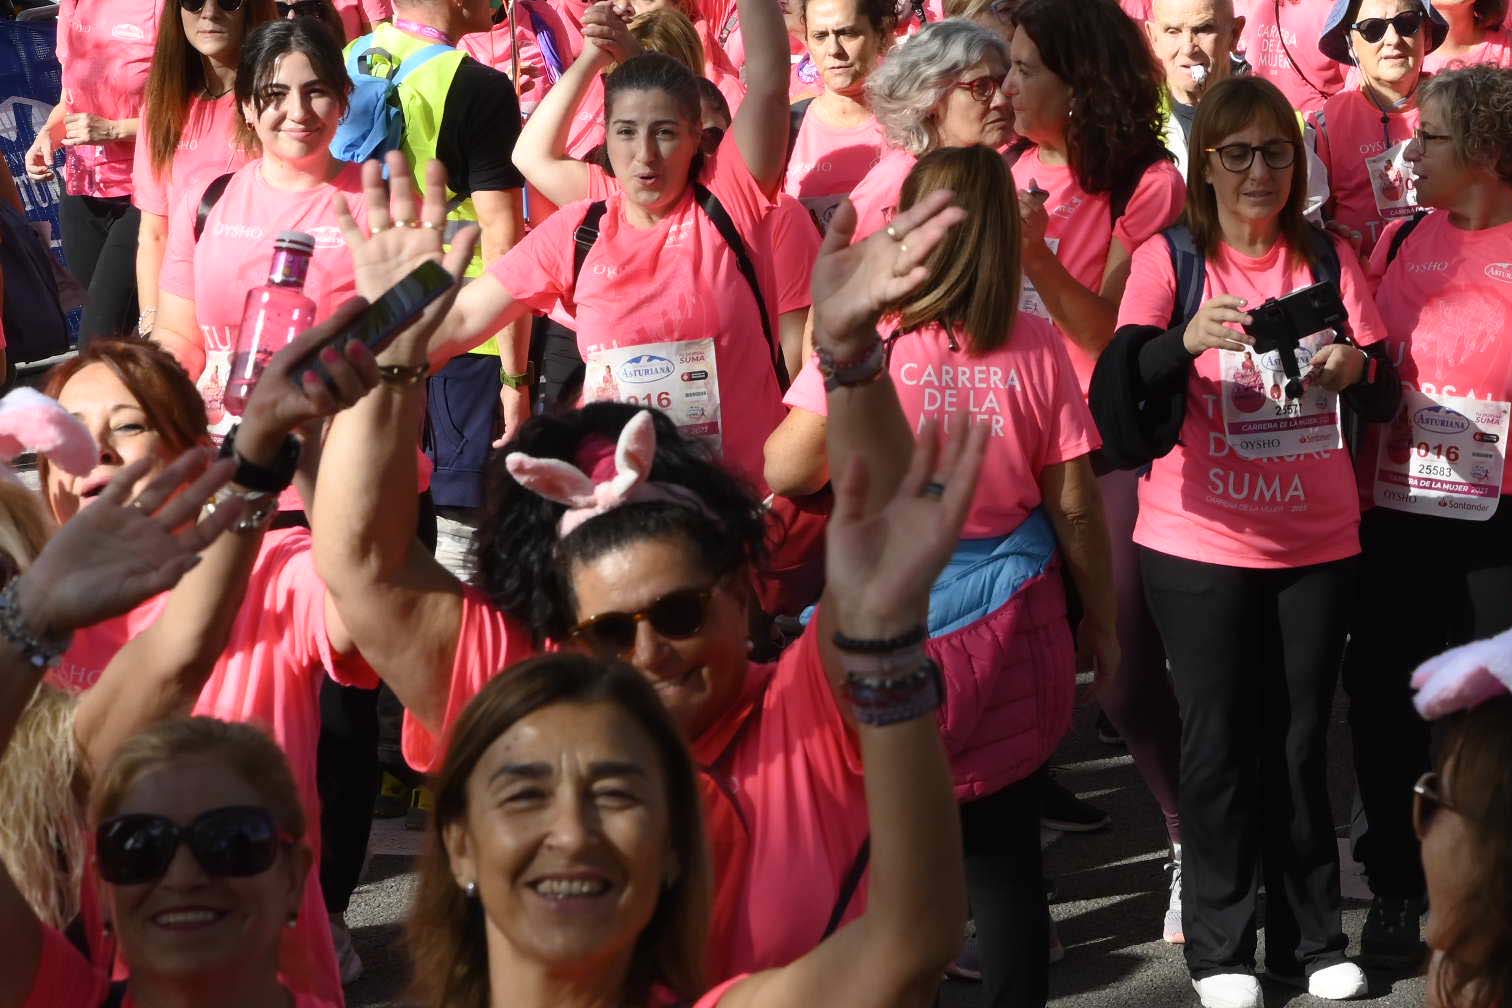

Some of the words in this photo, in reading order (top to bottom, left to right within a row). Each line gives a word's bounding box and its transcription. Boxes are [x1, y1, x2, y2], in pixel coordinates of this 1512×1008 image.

[200, 324, 232, 352] TU
[679, 354, 706, 365] SUMA
[622, 366, 672, 379] ASTURIANA
[900, 363, 1022, 392] CARRERA
[924, 388, 957, 412] DE
[969, 390, 1001, 413] LA
[1242, 422, 1279, 432] CARRERA
[1418, 413, 1466, 430] ASTURIANA
[1475, 416, 1501, 425] SUMA
[1240, 438, 1281, 450] OYSHO
[1416, 441, 1461, 463] 016
[1418, 463, 1453, 478] 25583
[1208, 467, 1306, 502] SUMA
[1419, 479, 1430, 488] DE
[1431, 480, 1442, 489] LA
[1442, 481, 1469, 493] MUJER
[1383, 489, 1418, 505] OYSHO
[1448, 498, 1490, 512] Santander
